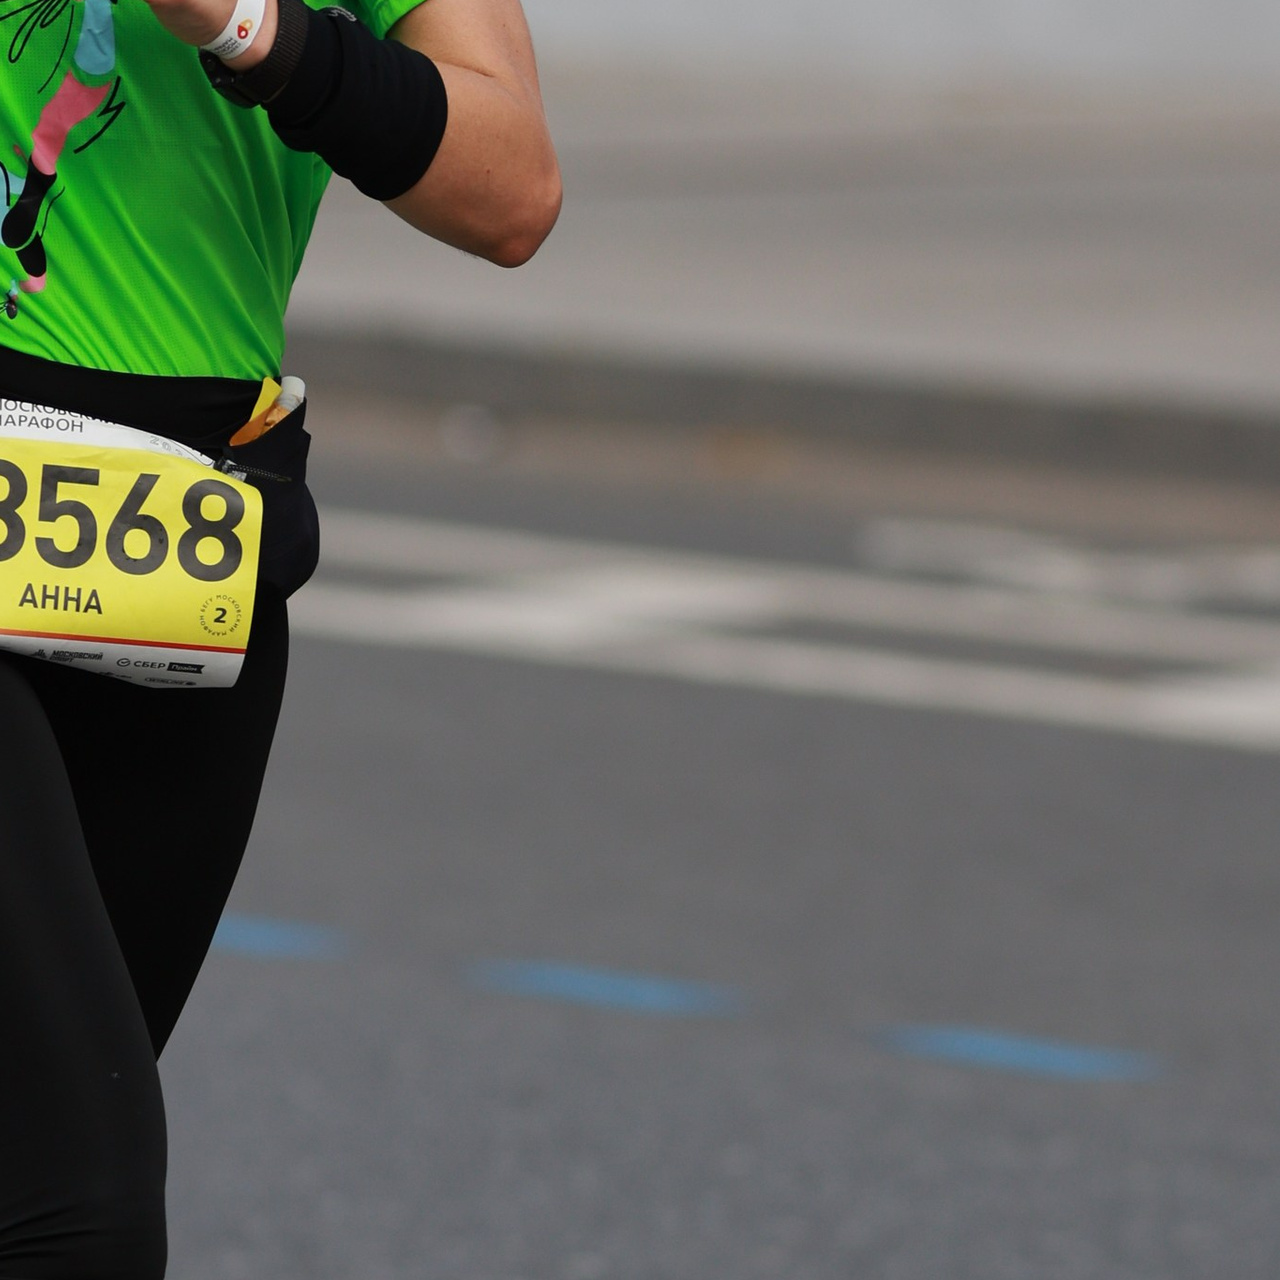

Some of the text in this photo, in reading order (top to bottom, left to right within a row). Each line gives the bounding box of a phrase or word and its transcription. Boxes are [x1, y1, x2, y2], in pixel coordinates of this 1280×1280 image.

[18, 583, 103, 615] АННА
[213, 607, 227, 623] 2
[133, 660, 166, 669] СБЕР
